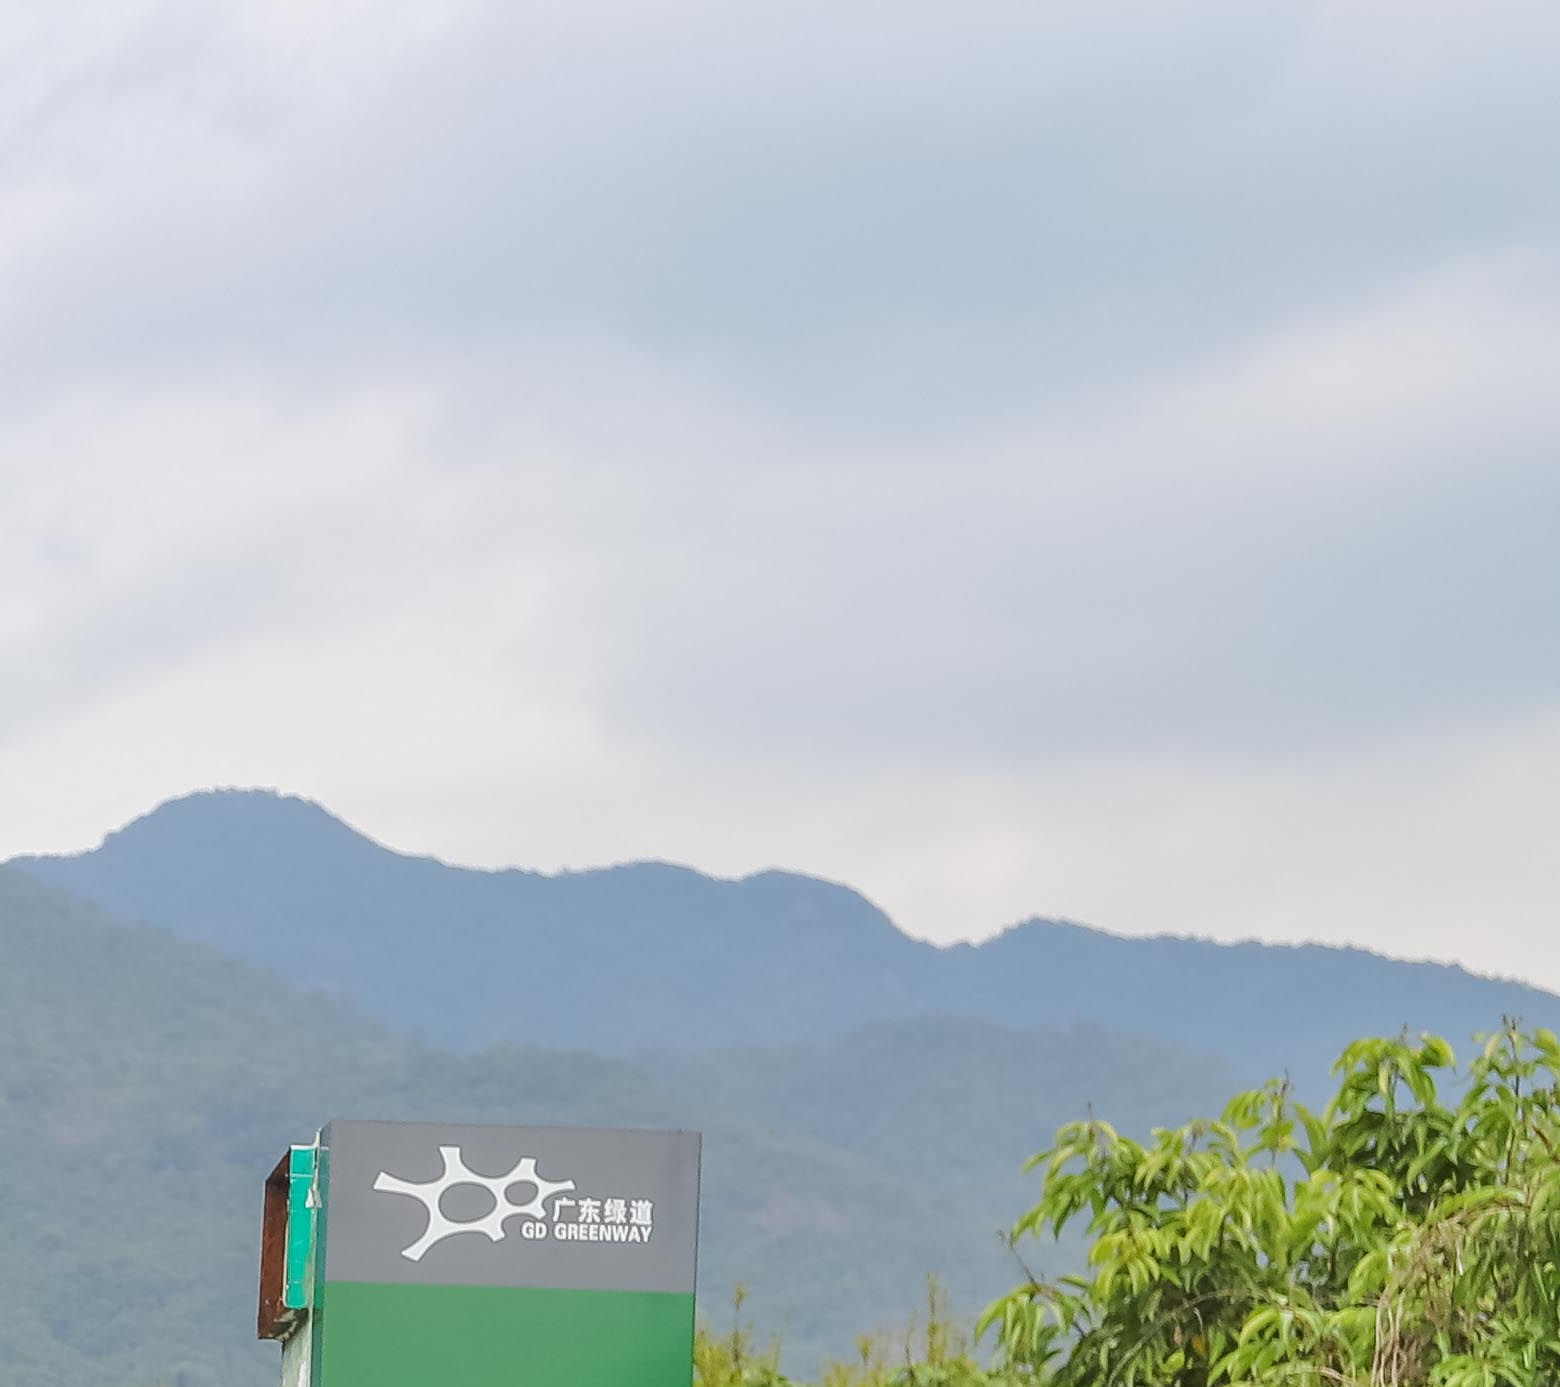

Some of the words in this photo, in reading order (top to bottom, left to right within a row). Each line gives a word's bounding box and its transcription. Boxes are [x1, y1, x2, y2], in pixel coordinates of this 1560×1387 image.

[553, 1197, 653, 1225] 广东绿道
[522, 1222, 547, 1239] GD
[554, 1223, 652, 1242] GREENWAY
